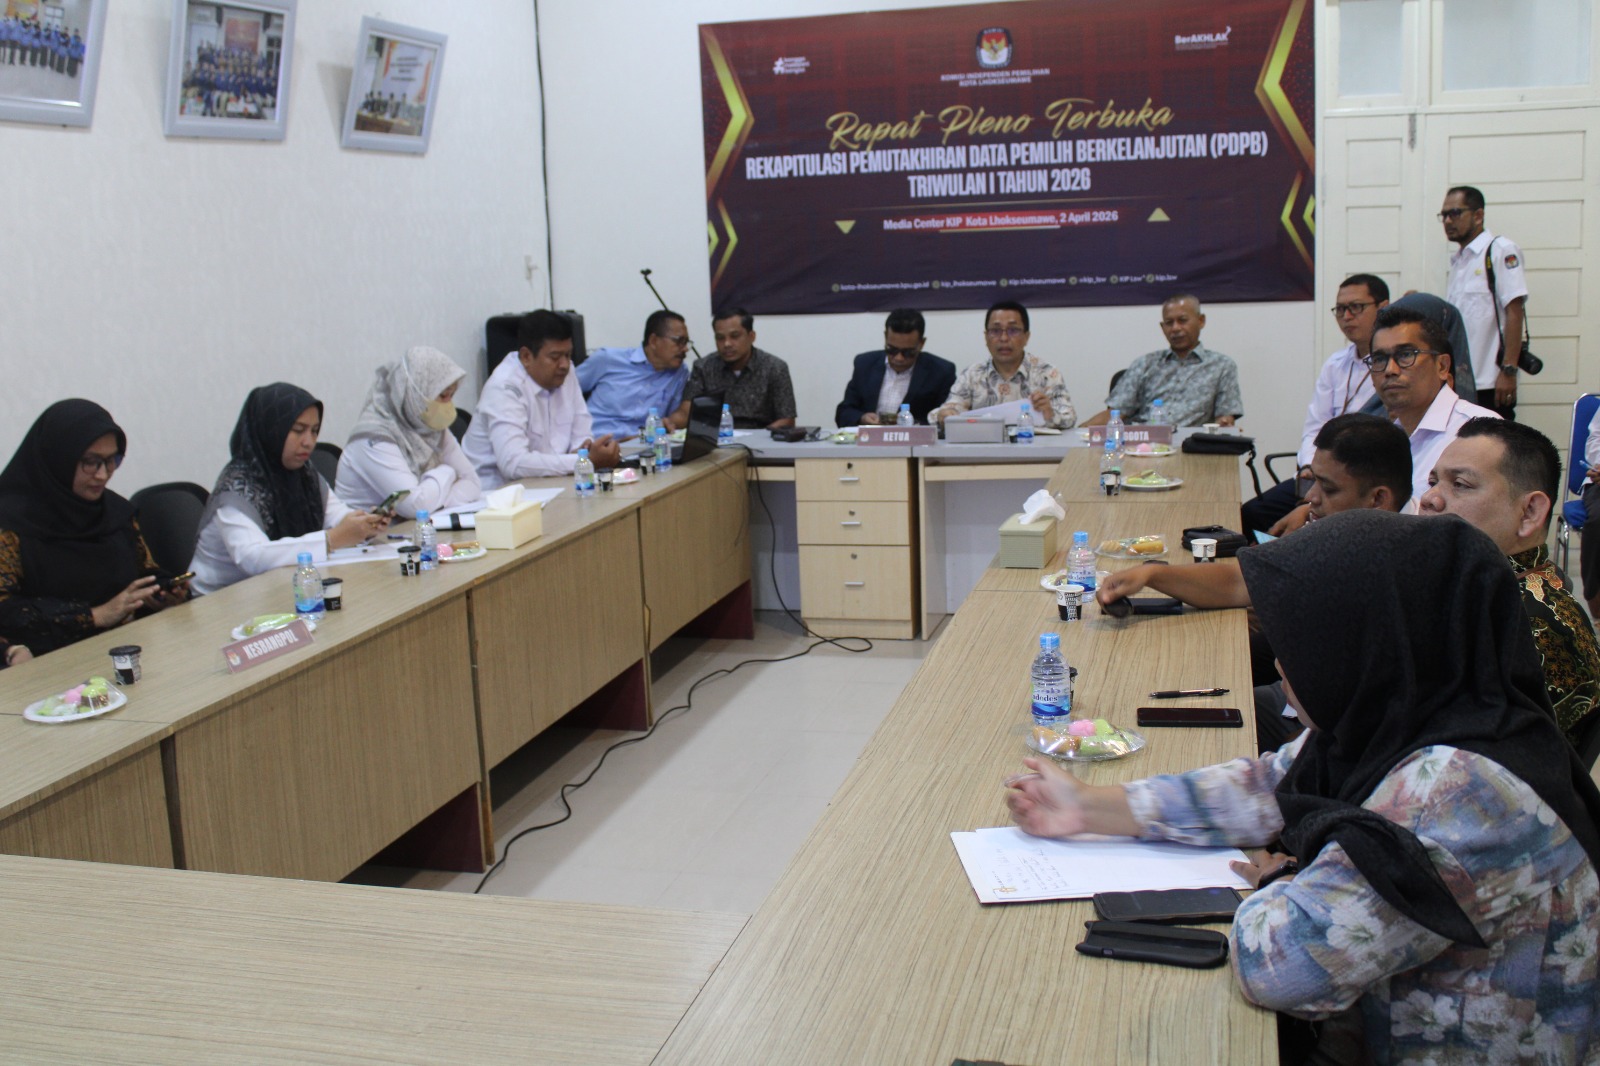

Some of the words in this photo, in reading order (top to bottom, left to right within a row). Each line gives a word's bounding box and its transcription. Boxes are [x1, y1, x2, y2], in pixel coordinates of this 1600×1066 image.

[959, 79, 977, 87] KOTA
[967, 71, 1011, 79] INDEPENDEN
[1011, 68, 1051, 76] PEMILIHAN
[825, 110, 934, 152] Rapat
[938, 105, 1034, 146] Pleno
[1045, 97, 1175, 139] Terbuka
[745, 152, 848, 180] REKAPITULASI
[849, 145, 967, 174] PEMUTAKHIRAN
[968, 143, 1009, 168] DATA
[1010, 140, 1073, 167] PEMILIH
[1075, 134, 1208, 163] BERKELANJUTAN
[1209, 131, 1269, 159] (PDPB)
[907, 172, 987, 198] TRIWULAN
[989, 171, 996, 194] I
[997, 168, 1049, 194] TAHUN
[1050, 167, 1092, 192] 2026
[883, 219, 913, 231] Media
[914, 218, 945, 229] Center
[946, 216, 963, 228] KIP
[966, 215, 988, 226] Kota
[989, 212, 1058, 225] Lhokseumawe,
[1059, 214, 1067, 223] 2
[1068, 211, 1091, 225] April
[1092, 210, 1119, 222] 2026
[883, 431, 910, 441] KETUA
[241, 628, 299, 660] KESBANGPOL
